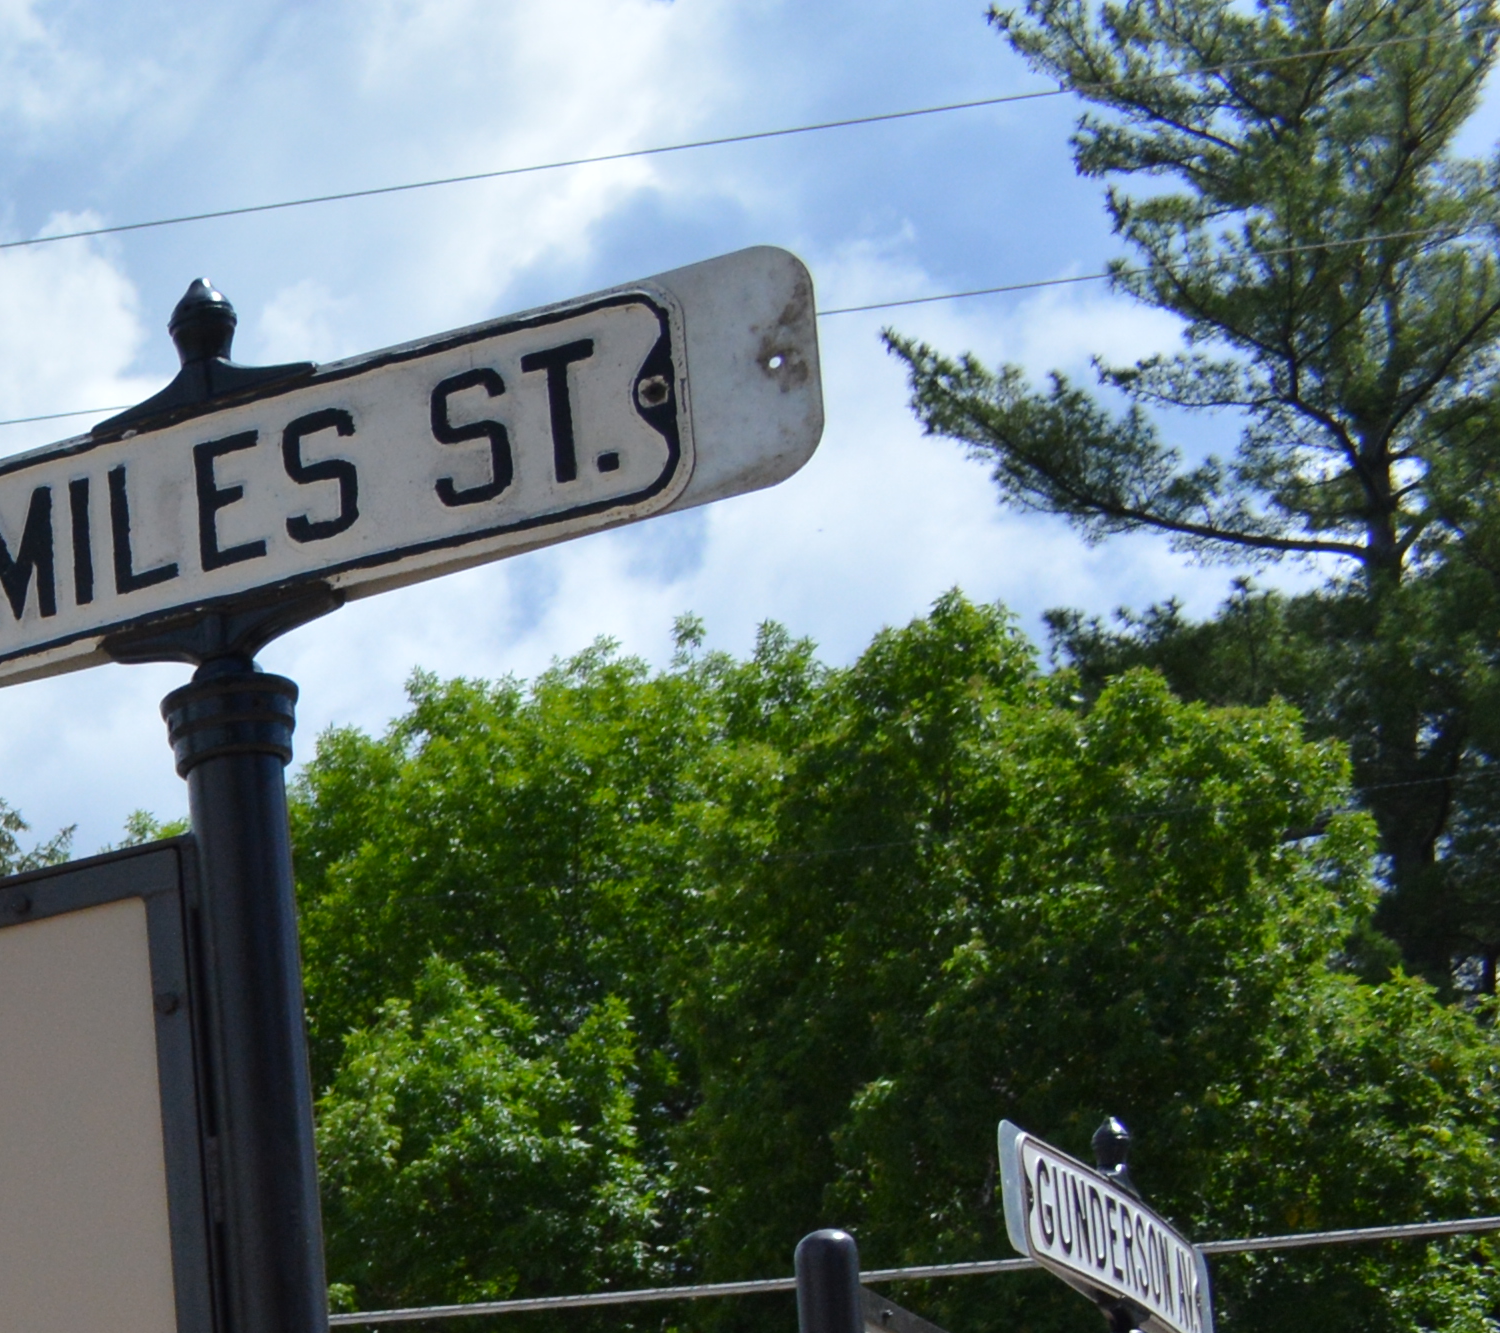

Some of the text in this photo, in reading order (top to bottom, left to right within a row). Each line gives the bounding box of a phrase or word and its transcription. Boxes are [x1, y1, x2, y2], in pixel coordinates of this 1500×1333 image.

[429, 337, 622, 509] ST.
[1035, 1156, 1198, 1333] GUNDERSON AV.
